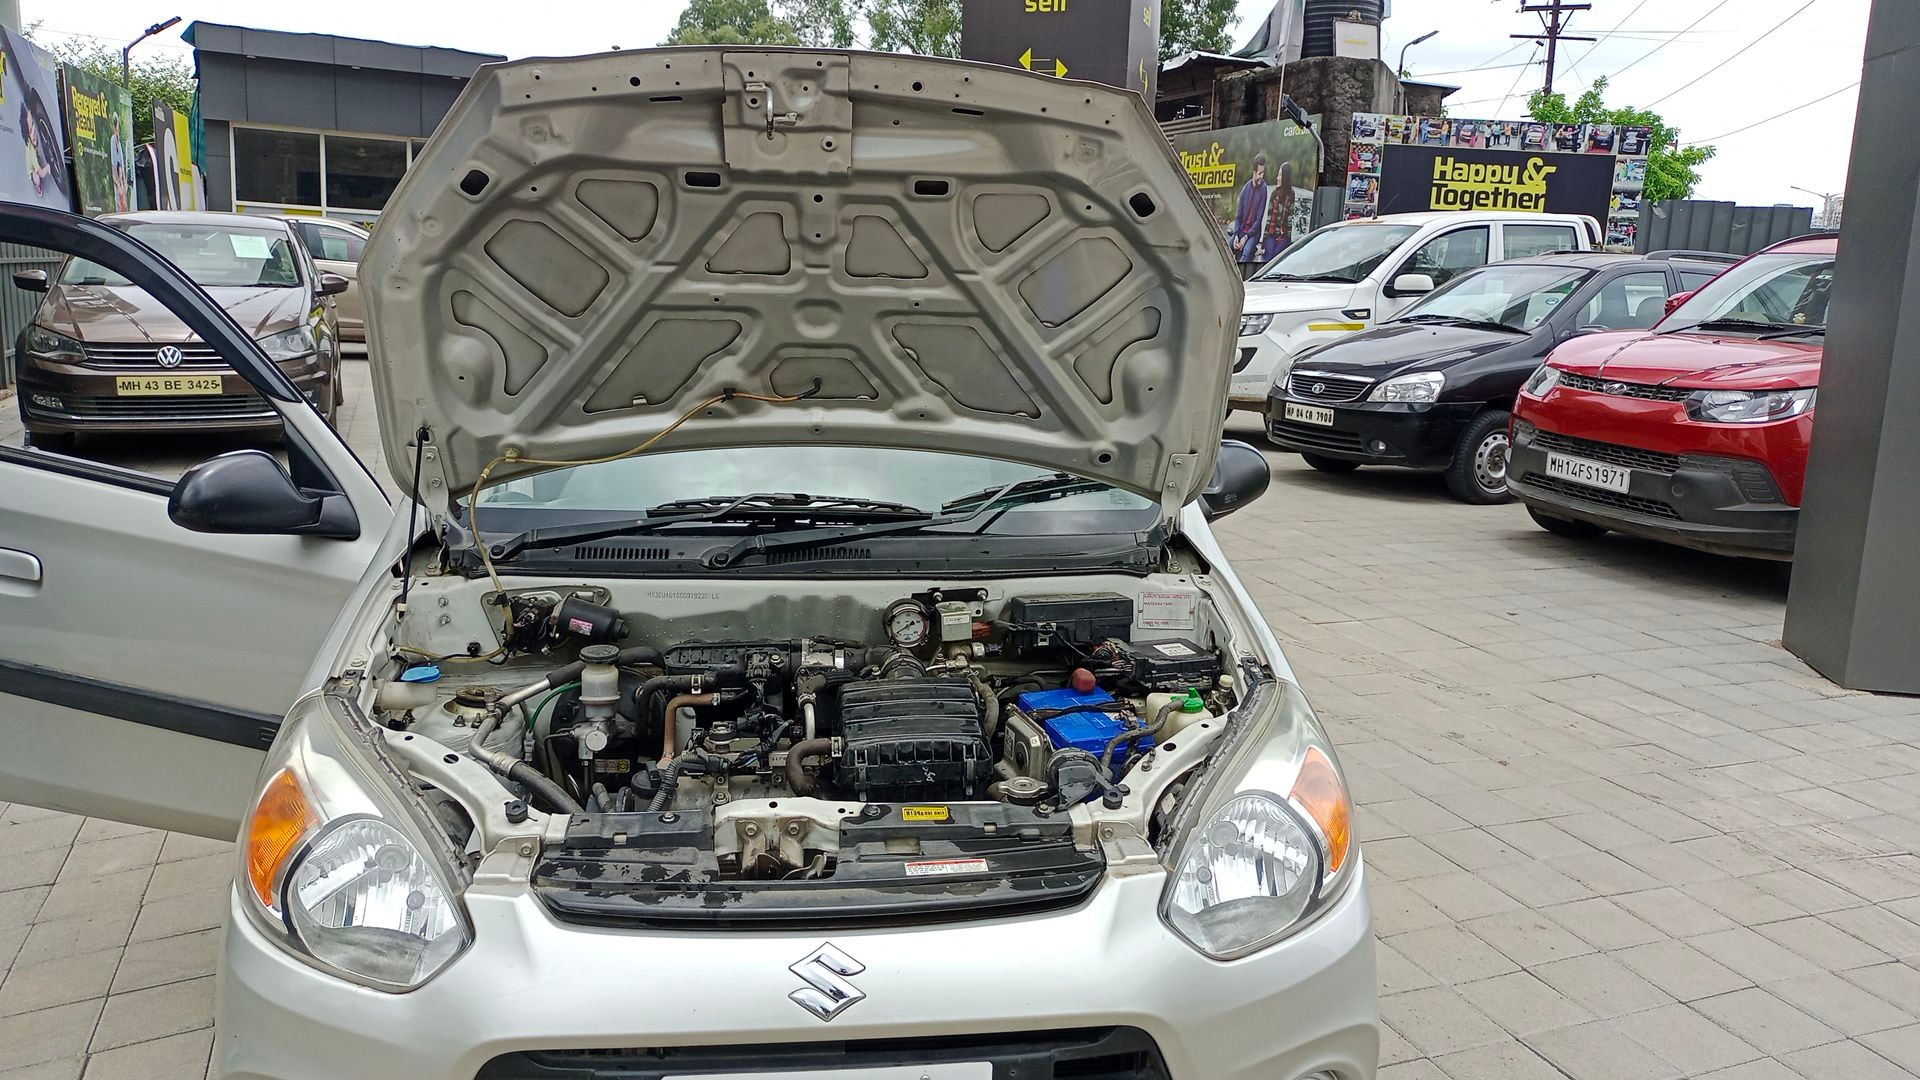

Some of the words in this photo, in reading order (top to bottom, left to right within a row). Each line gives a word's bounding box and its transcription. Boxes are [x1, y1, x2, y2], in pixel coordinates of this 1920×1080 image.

[1180, 150, 1207, 169] Trust
[1209, 142, 1224, 167] &
[1433, 156, 1519, 185] Happy
[1522, 157, 1557, 186] &
[1430, 183, 1547, 211] Together
[122, 381, 141, 391] MH
[145, 381, 159, 391] 43
[164, 380, 182, 390] BE
[188, 379, 218, 390] 3425
[1550, 456, 1625, 488] MH14FS1971
